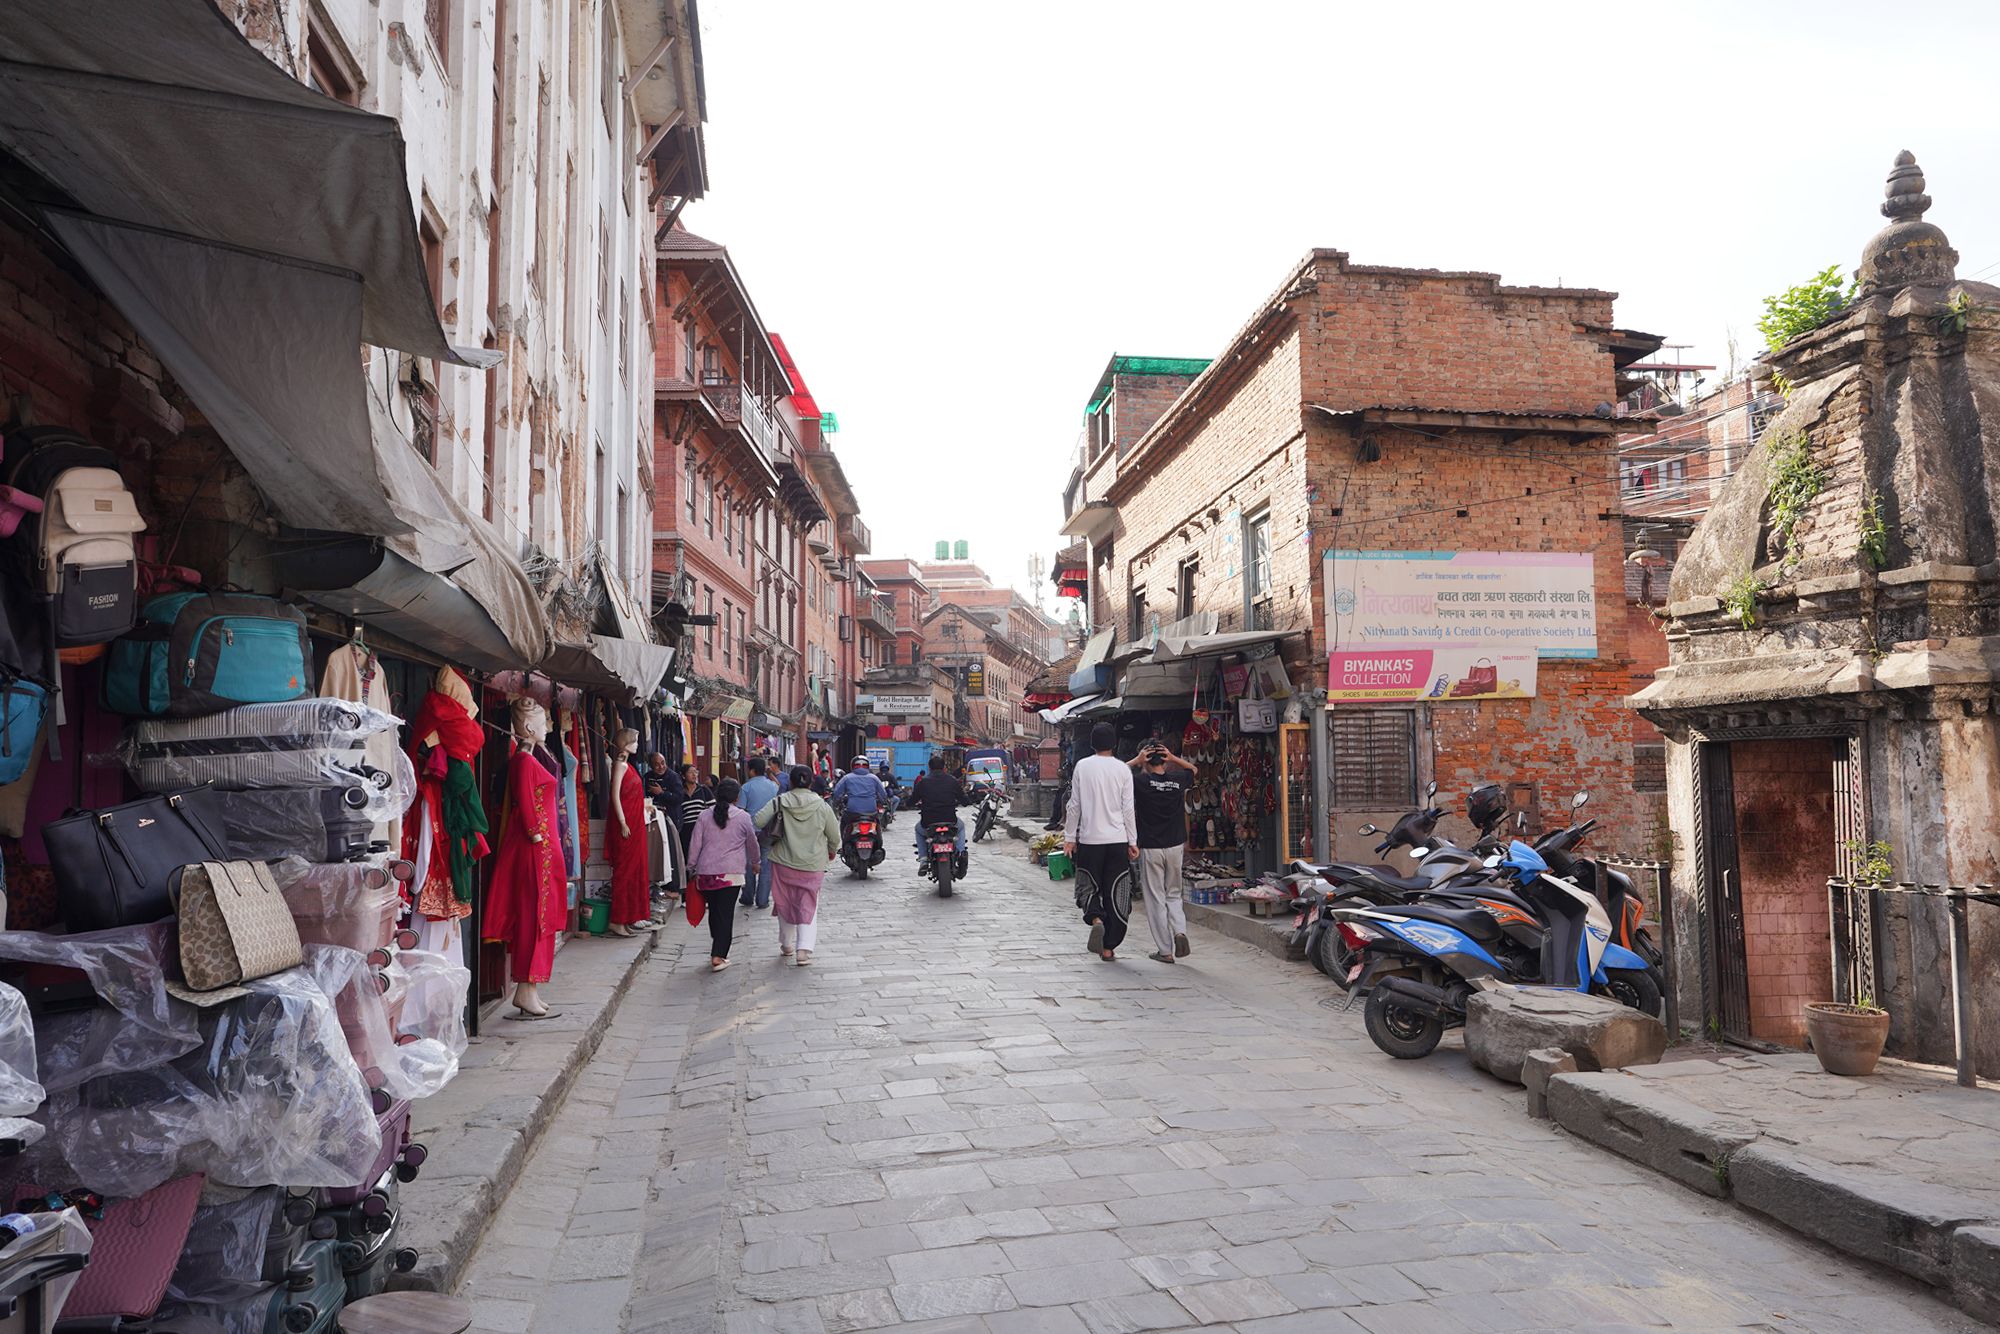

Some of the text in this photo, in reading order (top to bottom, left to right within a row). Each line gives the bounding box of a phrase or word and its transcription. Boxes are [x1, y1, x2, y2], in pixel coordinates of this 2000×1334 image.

[88, 593, 119, 606] FASHION
[1362, 588, 1434, 616] नित्यनाथ
[1437, 589, 1593, 603] बचत तथा ऋण सहकारी संस्था लि.
[1363, 626, 1409, 638] Nityanath
[1411, 626, 1443, 639] Saving
[1445, 627, 1452, 637] &
[1454, 626, 1481, 637] Credit
[1484, 626, 1541, 639] Co-operative
[1543, 626, 1576, 639] Society
[1343, 658, 1414, 673] BIYANKA'S
[1343, 672, 1411, 685] COLLECTION
[891, 696, 913, 704] Heritage
